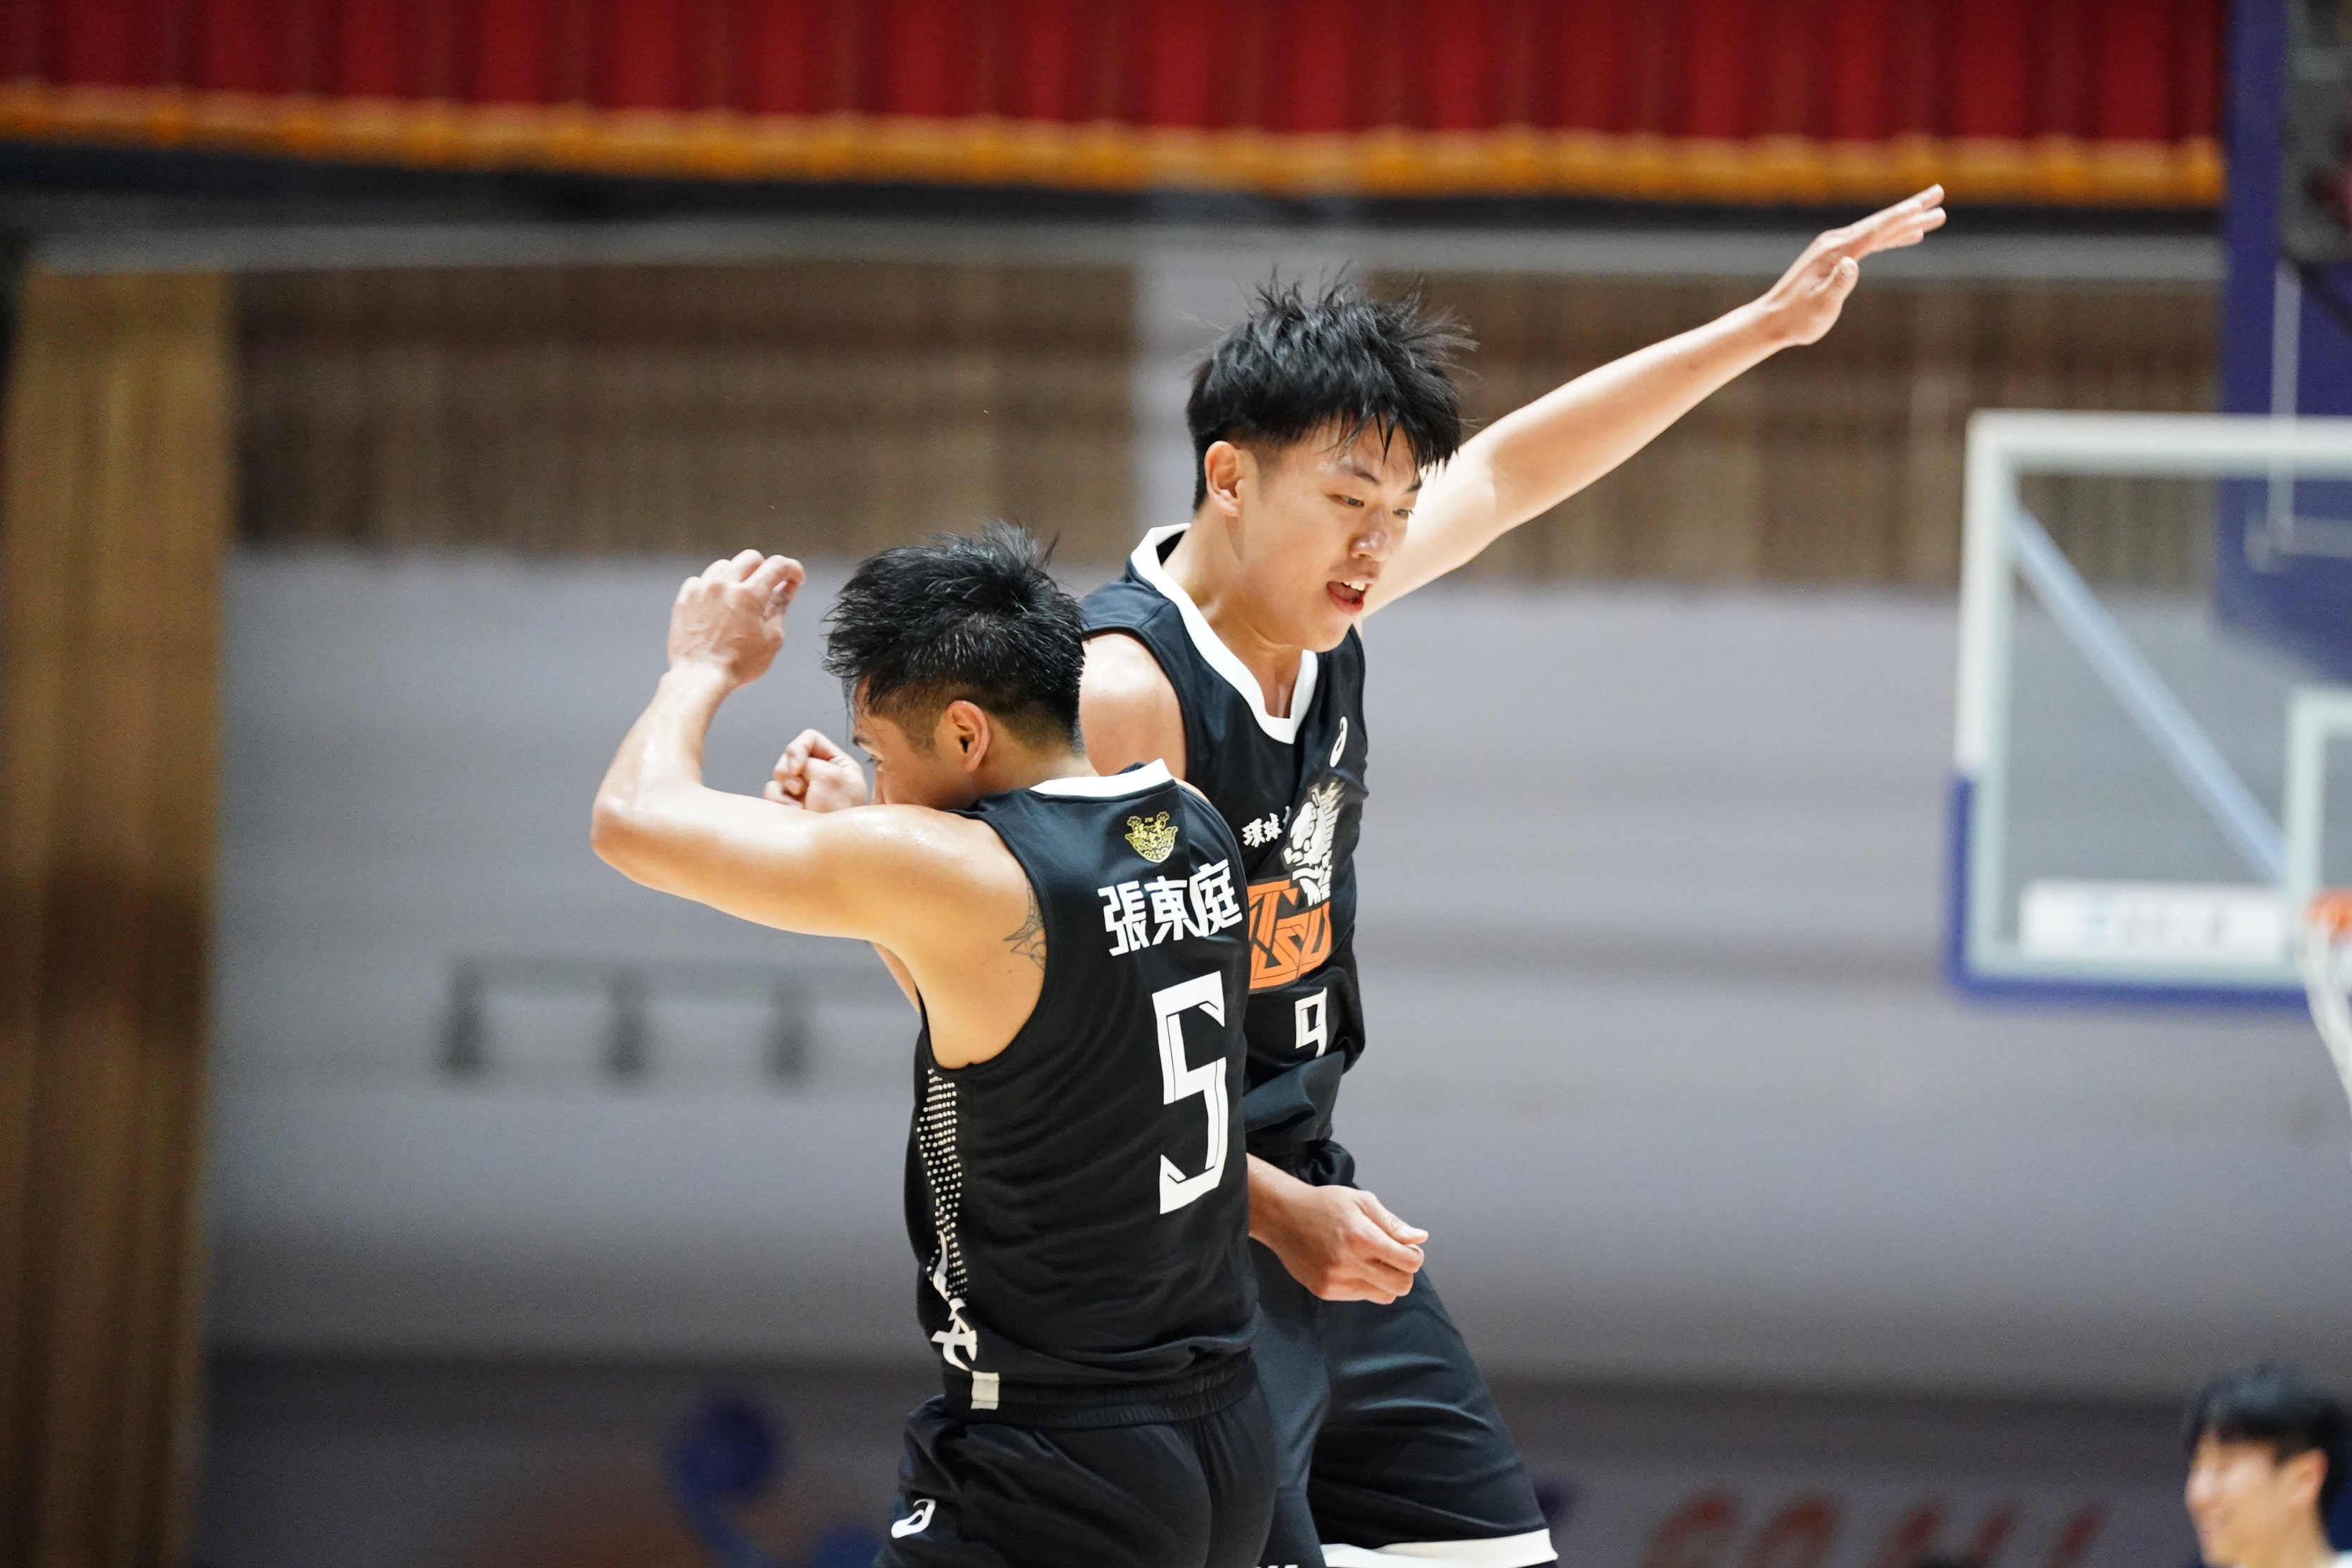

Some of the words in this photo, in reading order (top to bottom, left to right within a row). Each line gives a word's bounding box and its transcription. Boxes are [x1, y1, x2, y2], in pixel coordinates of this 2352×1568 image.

[1242, 806, 1292, 847] 環球
[1097, 859, 1243, 957] 張東庭
[1247, 879, 1333, 989] TSU
[1294, 987, 1327, 1057] 9
[1152, 971, 1227, 1215] 5
